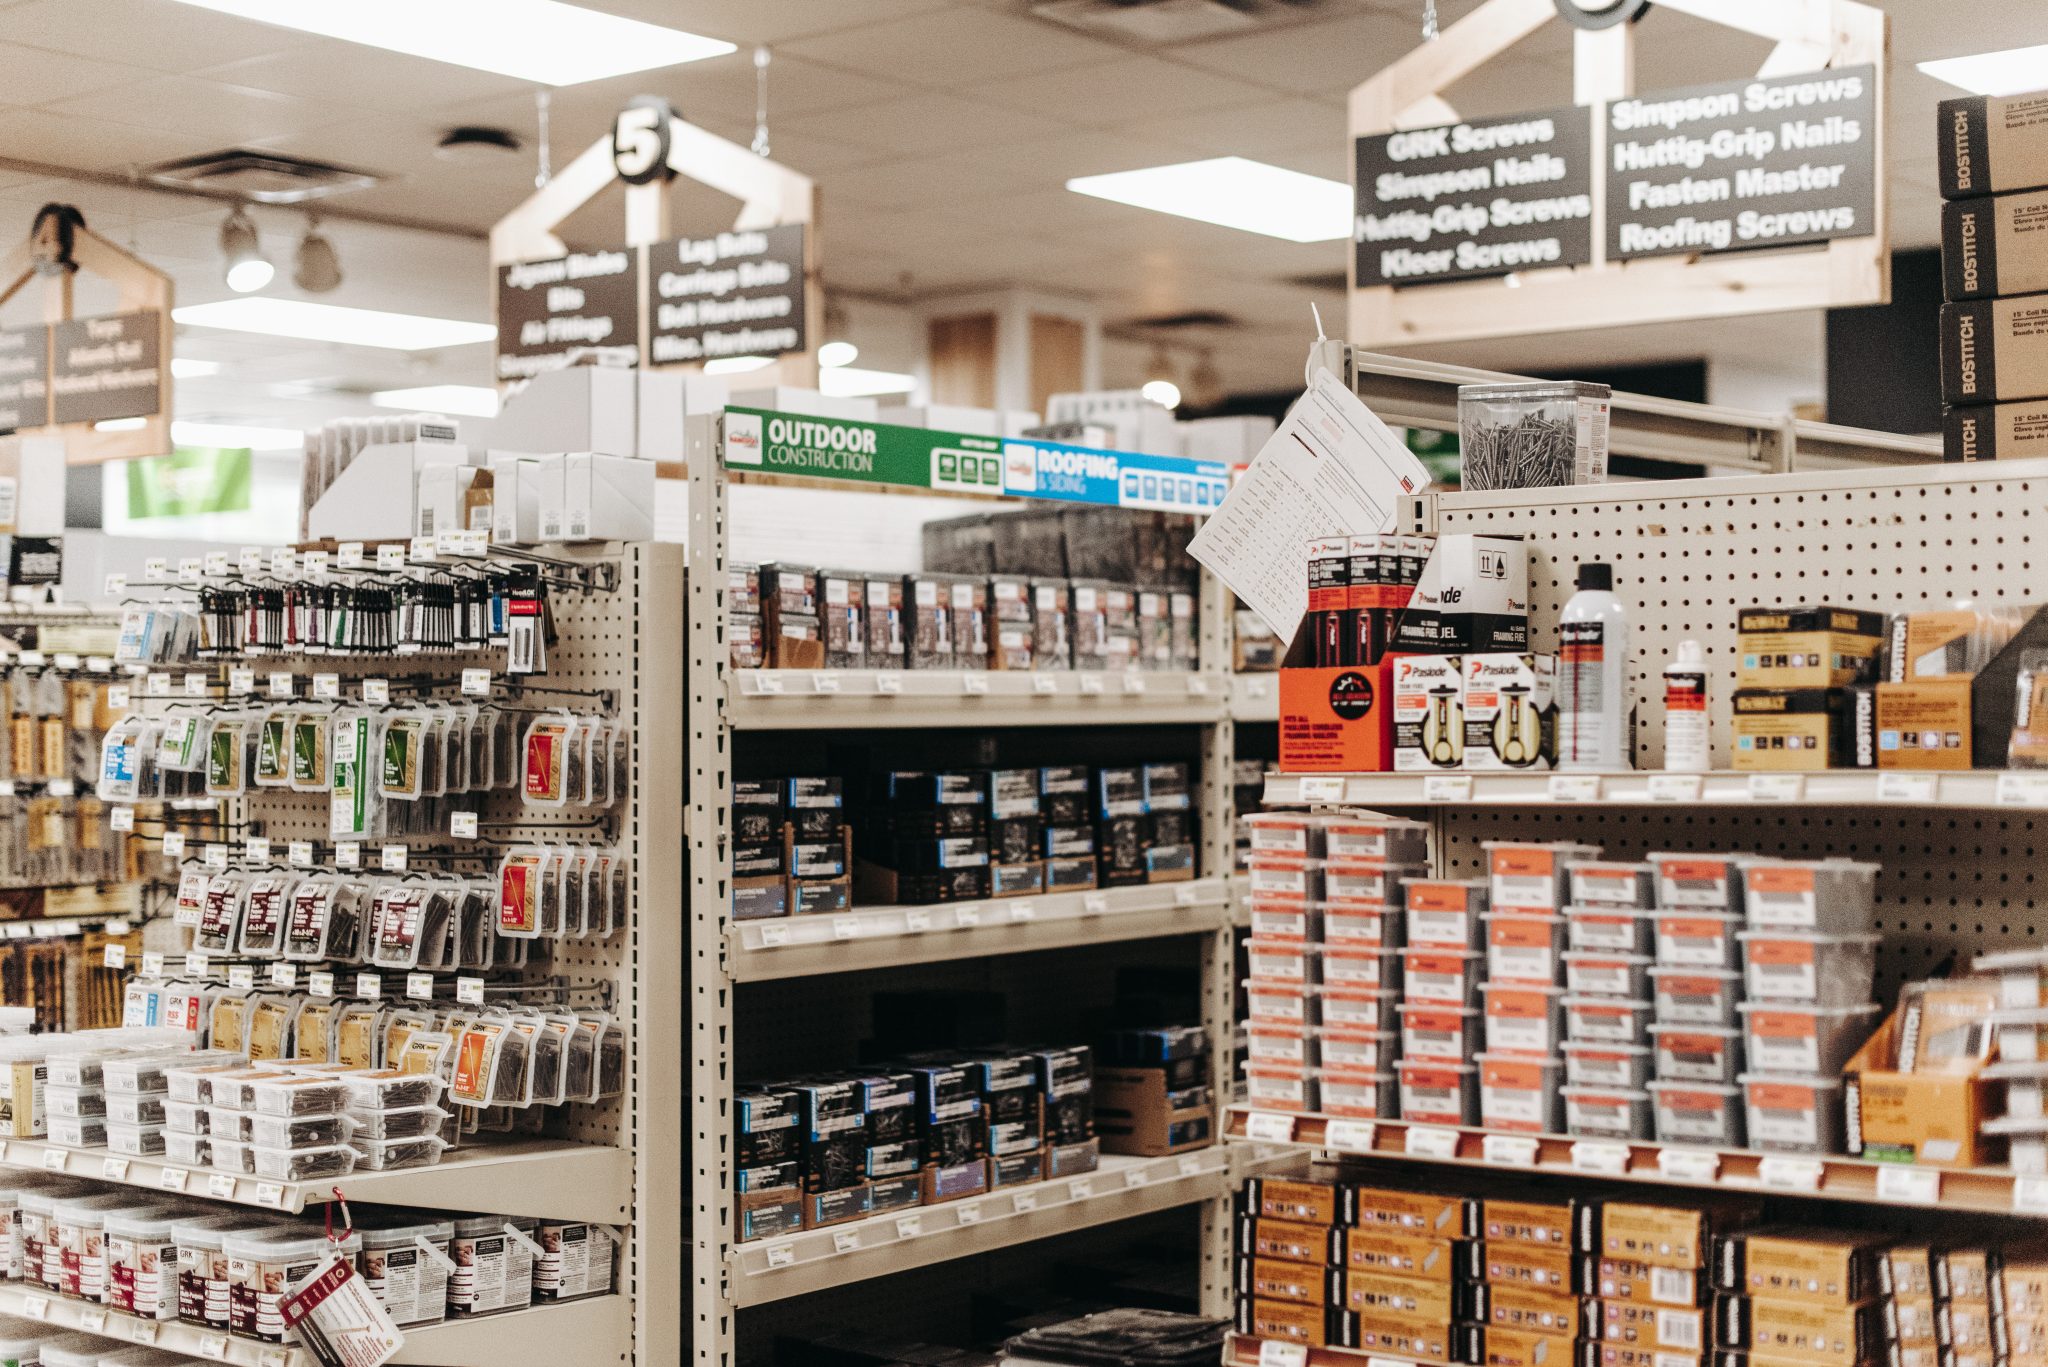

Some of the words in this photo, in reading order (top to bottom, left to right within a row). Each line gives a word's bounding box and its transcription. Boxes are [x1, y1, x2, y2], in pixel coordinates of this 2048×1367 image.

[1612, 93, 1739, 131] Simpson
[1744, 76, 1863, 113] Screws
[615, 107, 661, 176] 5
[1386, 128, 1450, 162] GRK
[1450, 118, 1555, 153] Screws
[1614, 127, 1775, 171] Huttig-Grip
[1780, 116, 1861, 151] Nails
[1954, 110, 1971, 190] BOSTITCH
[1375, 167, 1491, 202] Simpson
[1494, 153, 1566, 187] Nails
[1629, 176, 1730, 211] Fasten
[1735, 163, 1845, 198] Master
[1490, 194, 1591, 227] Screws
[1620, 217, 1732, 252] Roofing
[1737, 206, 1855, 240] Screws
[1380, 249, 1455, 278] Kleer
[1456, 237, 1561, 270] Screws
[1962, 213, 1978, 292] BOSTITCH
[1960, 315, 1976, 395] BOSTITCH
[768, 418, 877, 454] OUTDOOR
[1962, 419, 1976, 463] TITCH
[768, 445, 873, 472] CONSTRUCTION
[1037, 448, 1118, 480] ROOFING
[1412, 667, 1447, 677] Paslode
[1482, 664, 1519, 676] Paslode
[1856, 691, 1873, 766] BOSTITCH
[129, 992, 142, 1001] GRK
[167, 1010, 179, 1019] RSS
[169, 997, 183, 1006] GRK
[452, 1019, 466, 1027] GRK
[472, 1024, 486, 1032] GRK
[411, 1042, 425, 1051] GRK
[180, 1249, 193, 1258] GRK
[231, 1261, 245, 1270] GRK
